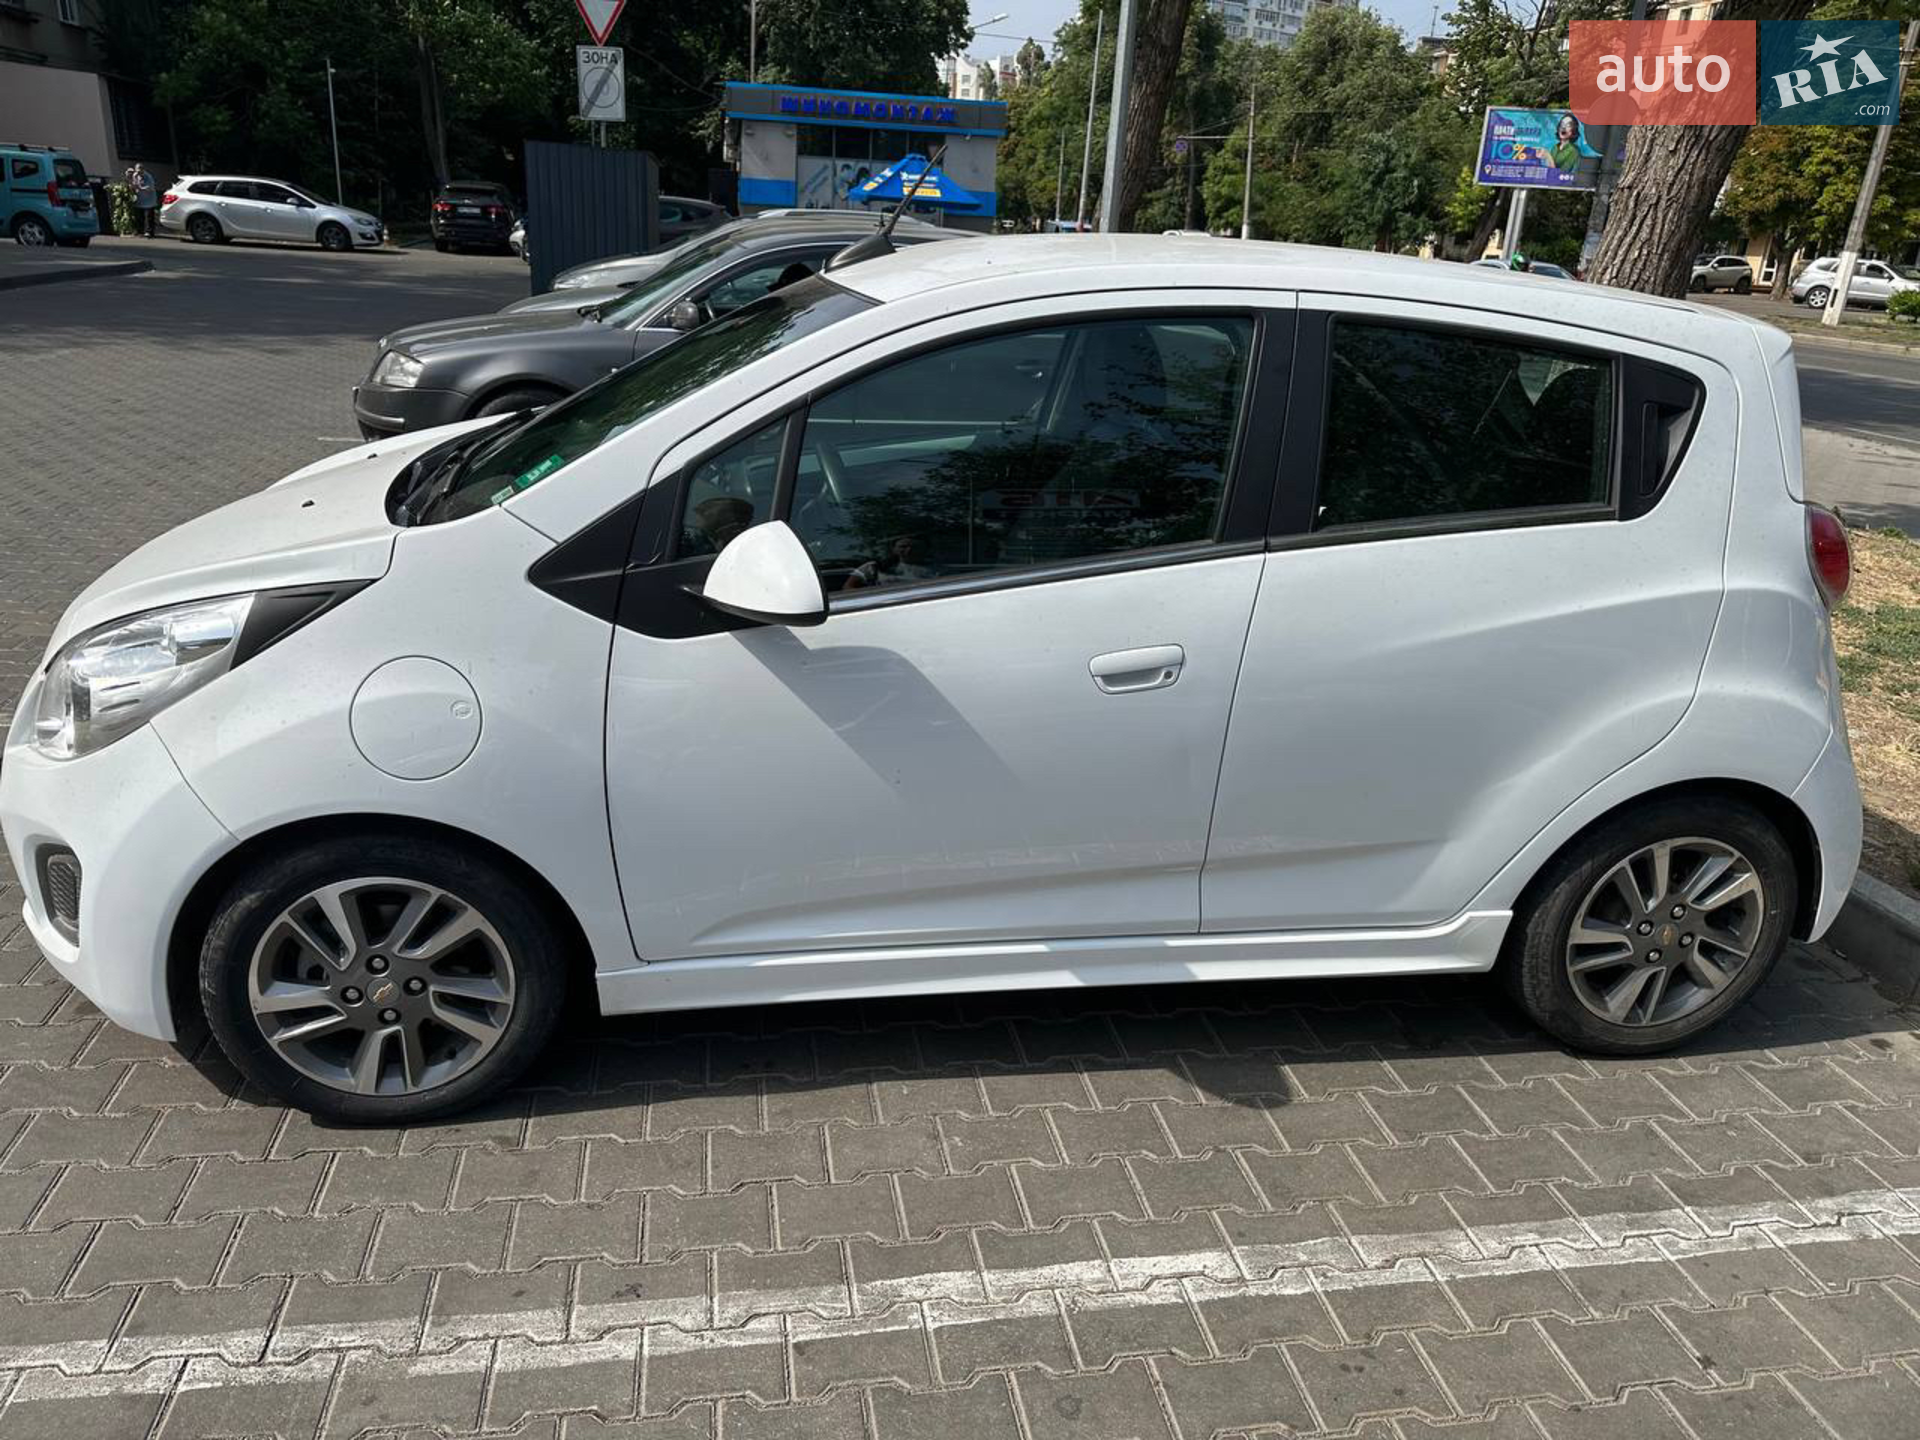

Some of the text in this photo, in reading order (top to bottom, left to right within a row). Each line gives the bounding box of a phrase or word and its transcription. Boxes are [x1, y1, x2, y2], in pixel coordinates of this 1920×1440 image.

[582, 51, 619, 65] ЗОНА
[780, 96, 956, 121] ШИНОМОНТАЖ
[1491, 141, 1527, 160] 10%
